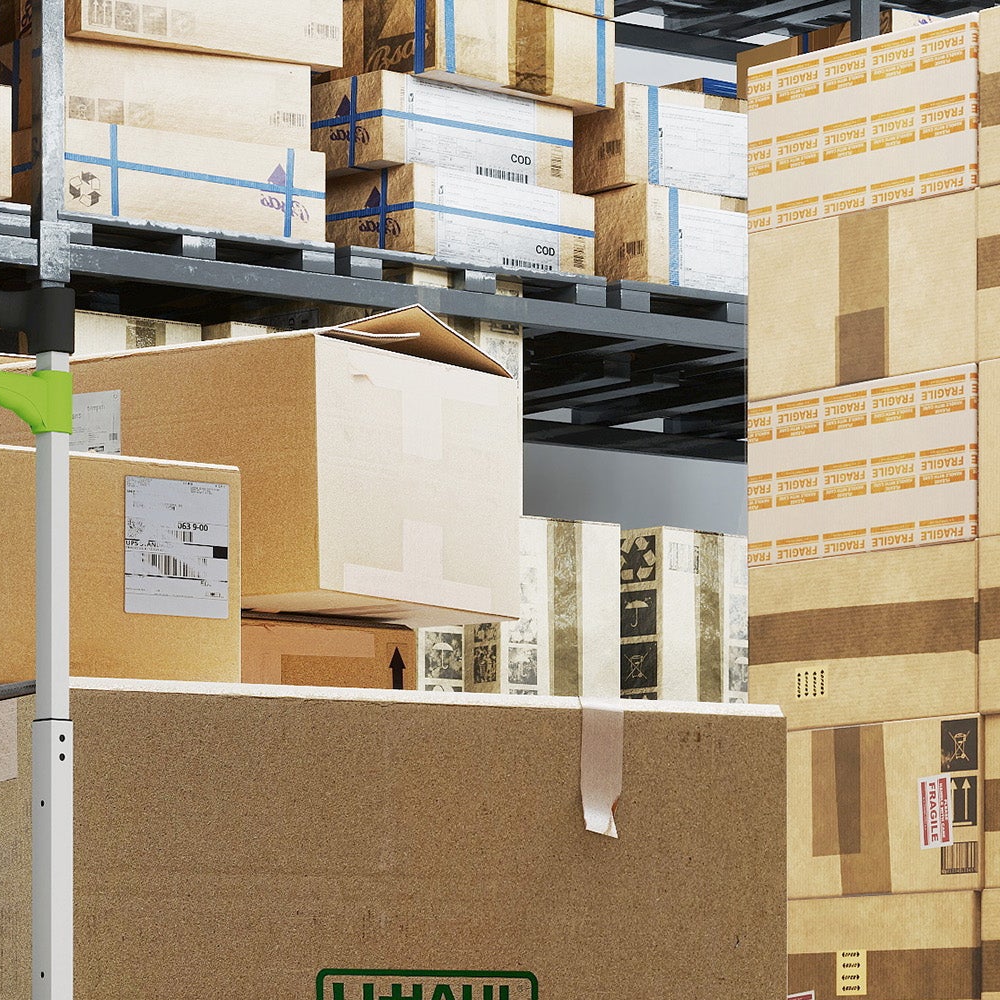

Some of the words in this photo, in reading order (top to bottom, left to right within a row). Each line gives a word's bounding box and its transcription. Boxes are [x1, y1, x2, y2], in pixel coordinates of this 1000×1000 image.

[921, 34, 964, 53] FRAGILE
[872, 48, 914, 64] FRAGILE
[824, 59, 866, 76] FRAGILE
[778, 70, 818, 87] FRAGILE
[748, 81, 771, 93] FRAG
[921, 107, 964, 124] FRAGILE
[872, 117, 914, 134] FRAGILE
[824, 128, 866, 144] FRAGILE
[777, 139, 817, 155] FRAGILE
[510, 153, 532, 166] COD
[748, 149, 770, 162] FRAG
[921, 177, 963, 193] FRAGILE
[872, 188, 913, 204] FRAGILE
[824, 198, 865, 214] FRAGILE
[777, 207, 817, 223] FRAGILE
[748, 217, 770, 229] FRAG
[535, 244, 556, 257] COD
[921, 385, 964, 400] FRAGILE
[872, 393, 914, 407] FRAGILE
[824, 401, 866, 415] FRAGILE
[748, 416, 771, 427] FRAG
[778, 409, 818, 423] FRAGILE
[872, 463, 914, 477] FRAGILE
[921, 456, 964, 471] FRAGILE
[824, 470, 866, 483] FRAGILE
[748, 485, 770, 495] FRAG
[777, 478, 817, 491] FRAGILE
[872, 533, 914, 547] FRAGILE
[921, 526, 963, 540] FRAGILE
[777, 546, 817, 559] FRAGILE
[824, 540, 865, 553] FRAGILE
[748, 552, 770, 563] FRAG
[929, 782, 939, 842] FRAGILE
